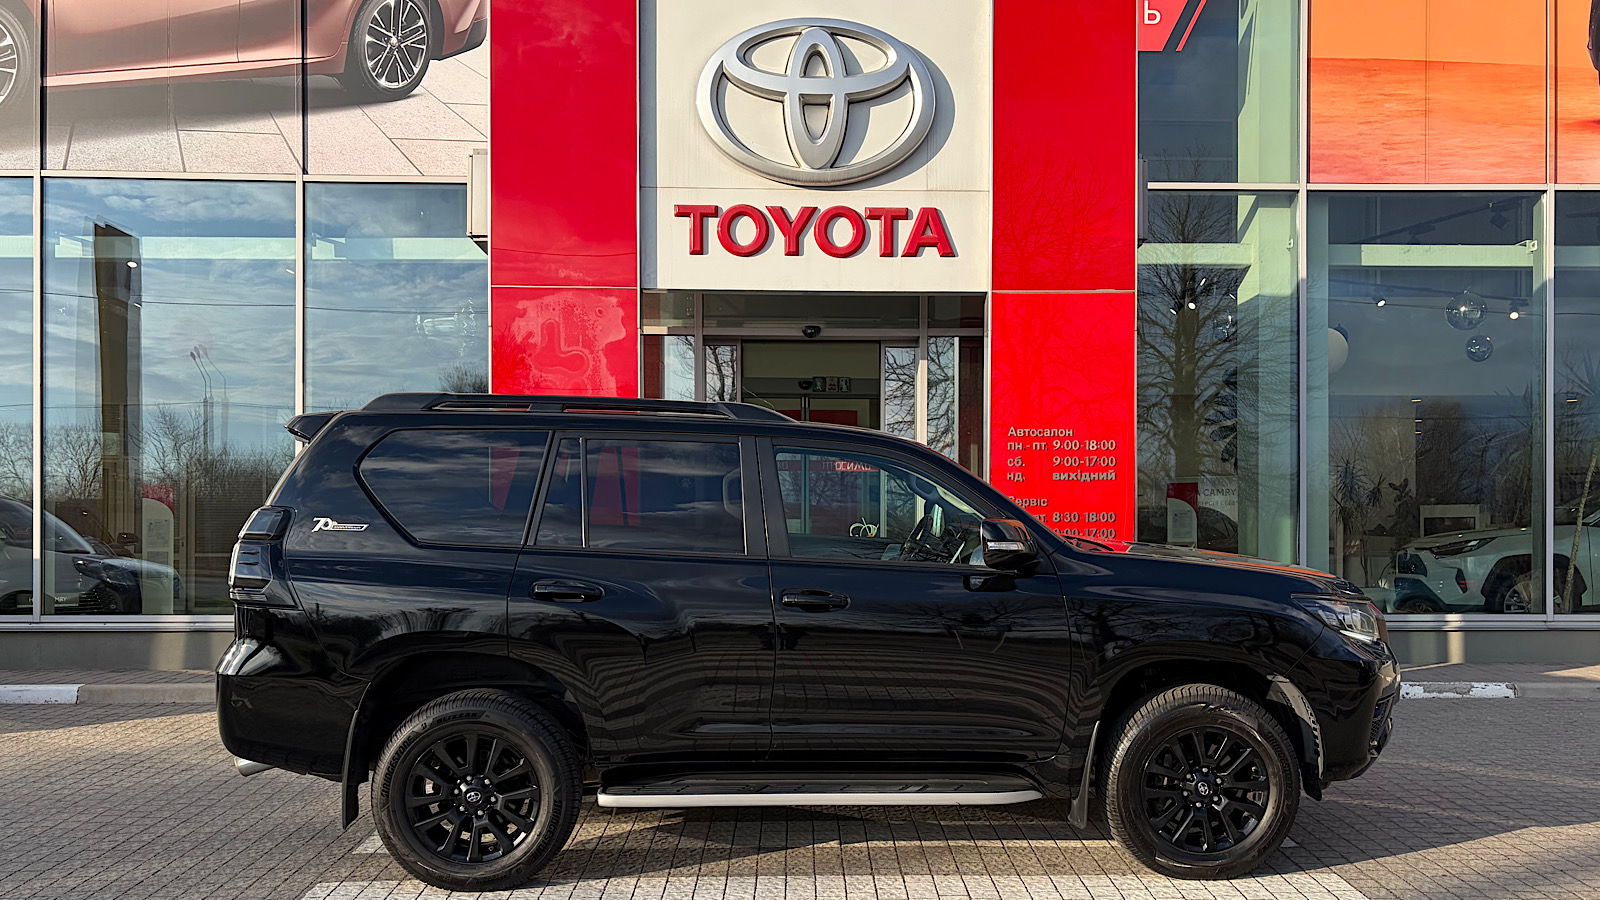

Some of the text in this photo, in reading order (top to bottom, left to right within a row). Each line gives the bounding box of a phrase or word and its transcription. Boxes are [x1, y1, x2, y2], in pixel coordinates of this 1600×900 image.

[674, 204, 955, 258] TOYOTA
[1007, 427, 1073, 437] Автосалон
[1053, 440, 1116, 451] 9:00-18:00
[1007, 456, 1116, 467] сб. 9:00-17:00
[1007, 470, 1116, 482] нд. вихідний
[1203, 488, 1237, 497] CAMRY
[381, 735, 415, 799] BRIDGESTONE
